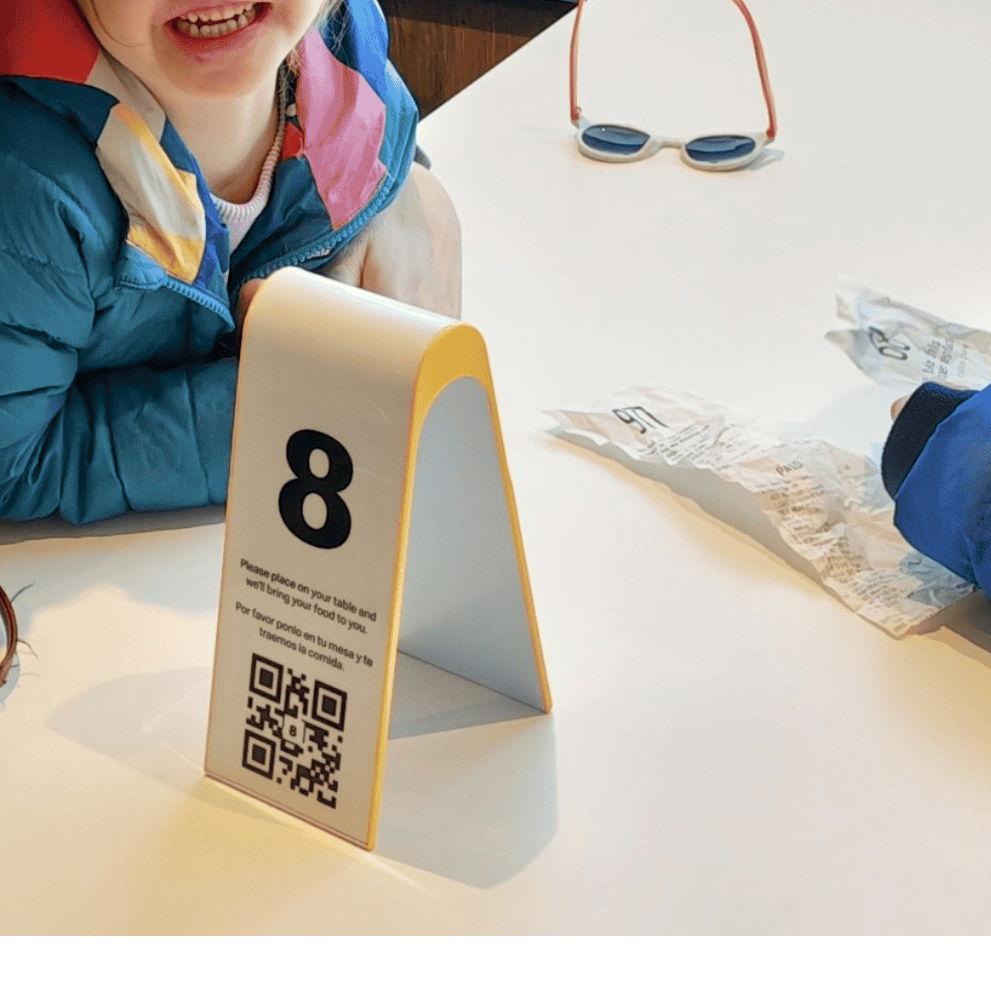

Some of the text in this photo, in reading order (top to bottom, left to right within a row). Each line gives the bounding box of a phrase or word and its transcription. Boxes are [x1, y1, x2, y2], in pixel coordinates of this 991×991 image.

[278, 428, 354, 549] 8
[240, 558, 377, 622] Please place on your table and
[245, 577, 368, 635] we'll bring your food to you.
[235, 601, 251, 615] Por
[252, 608, 275, 625] favor
[303, 632, 316, 643] en
[317, 635, 327, 648] tu
[328, 641, 355, 659] mesa
[356, 653, 363, 664] y
[363, 655, 374, 667] te
[259, 627, 345, 671] traemos la comida.
[289, 724, 297, 737] 8
